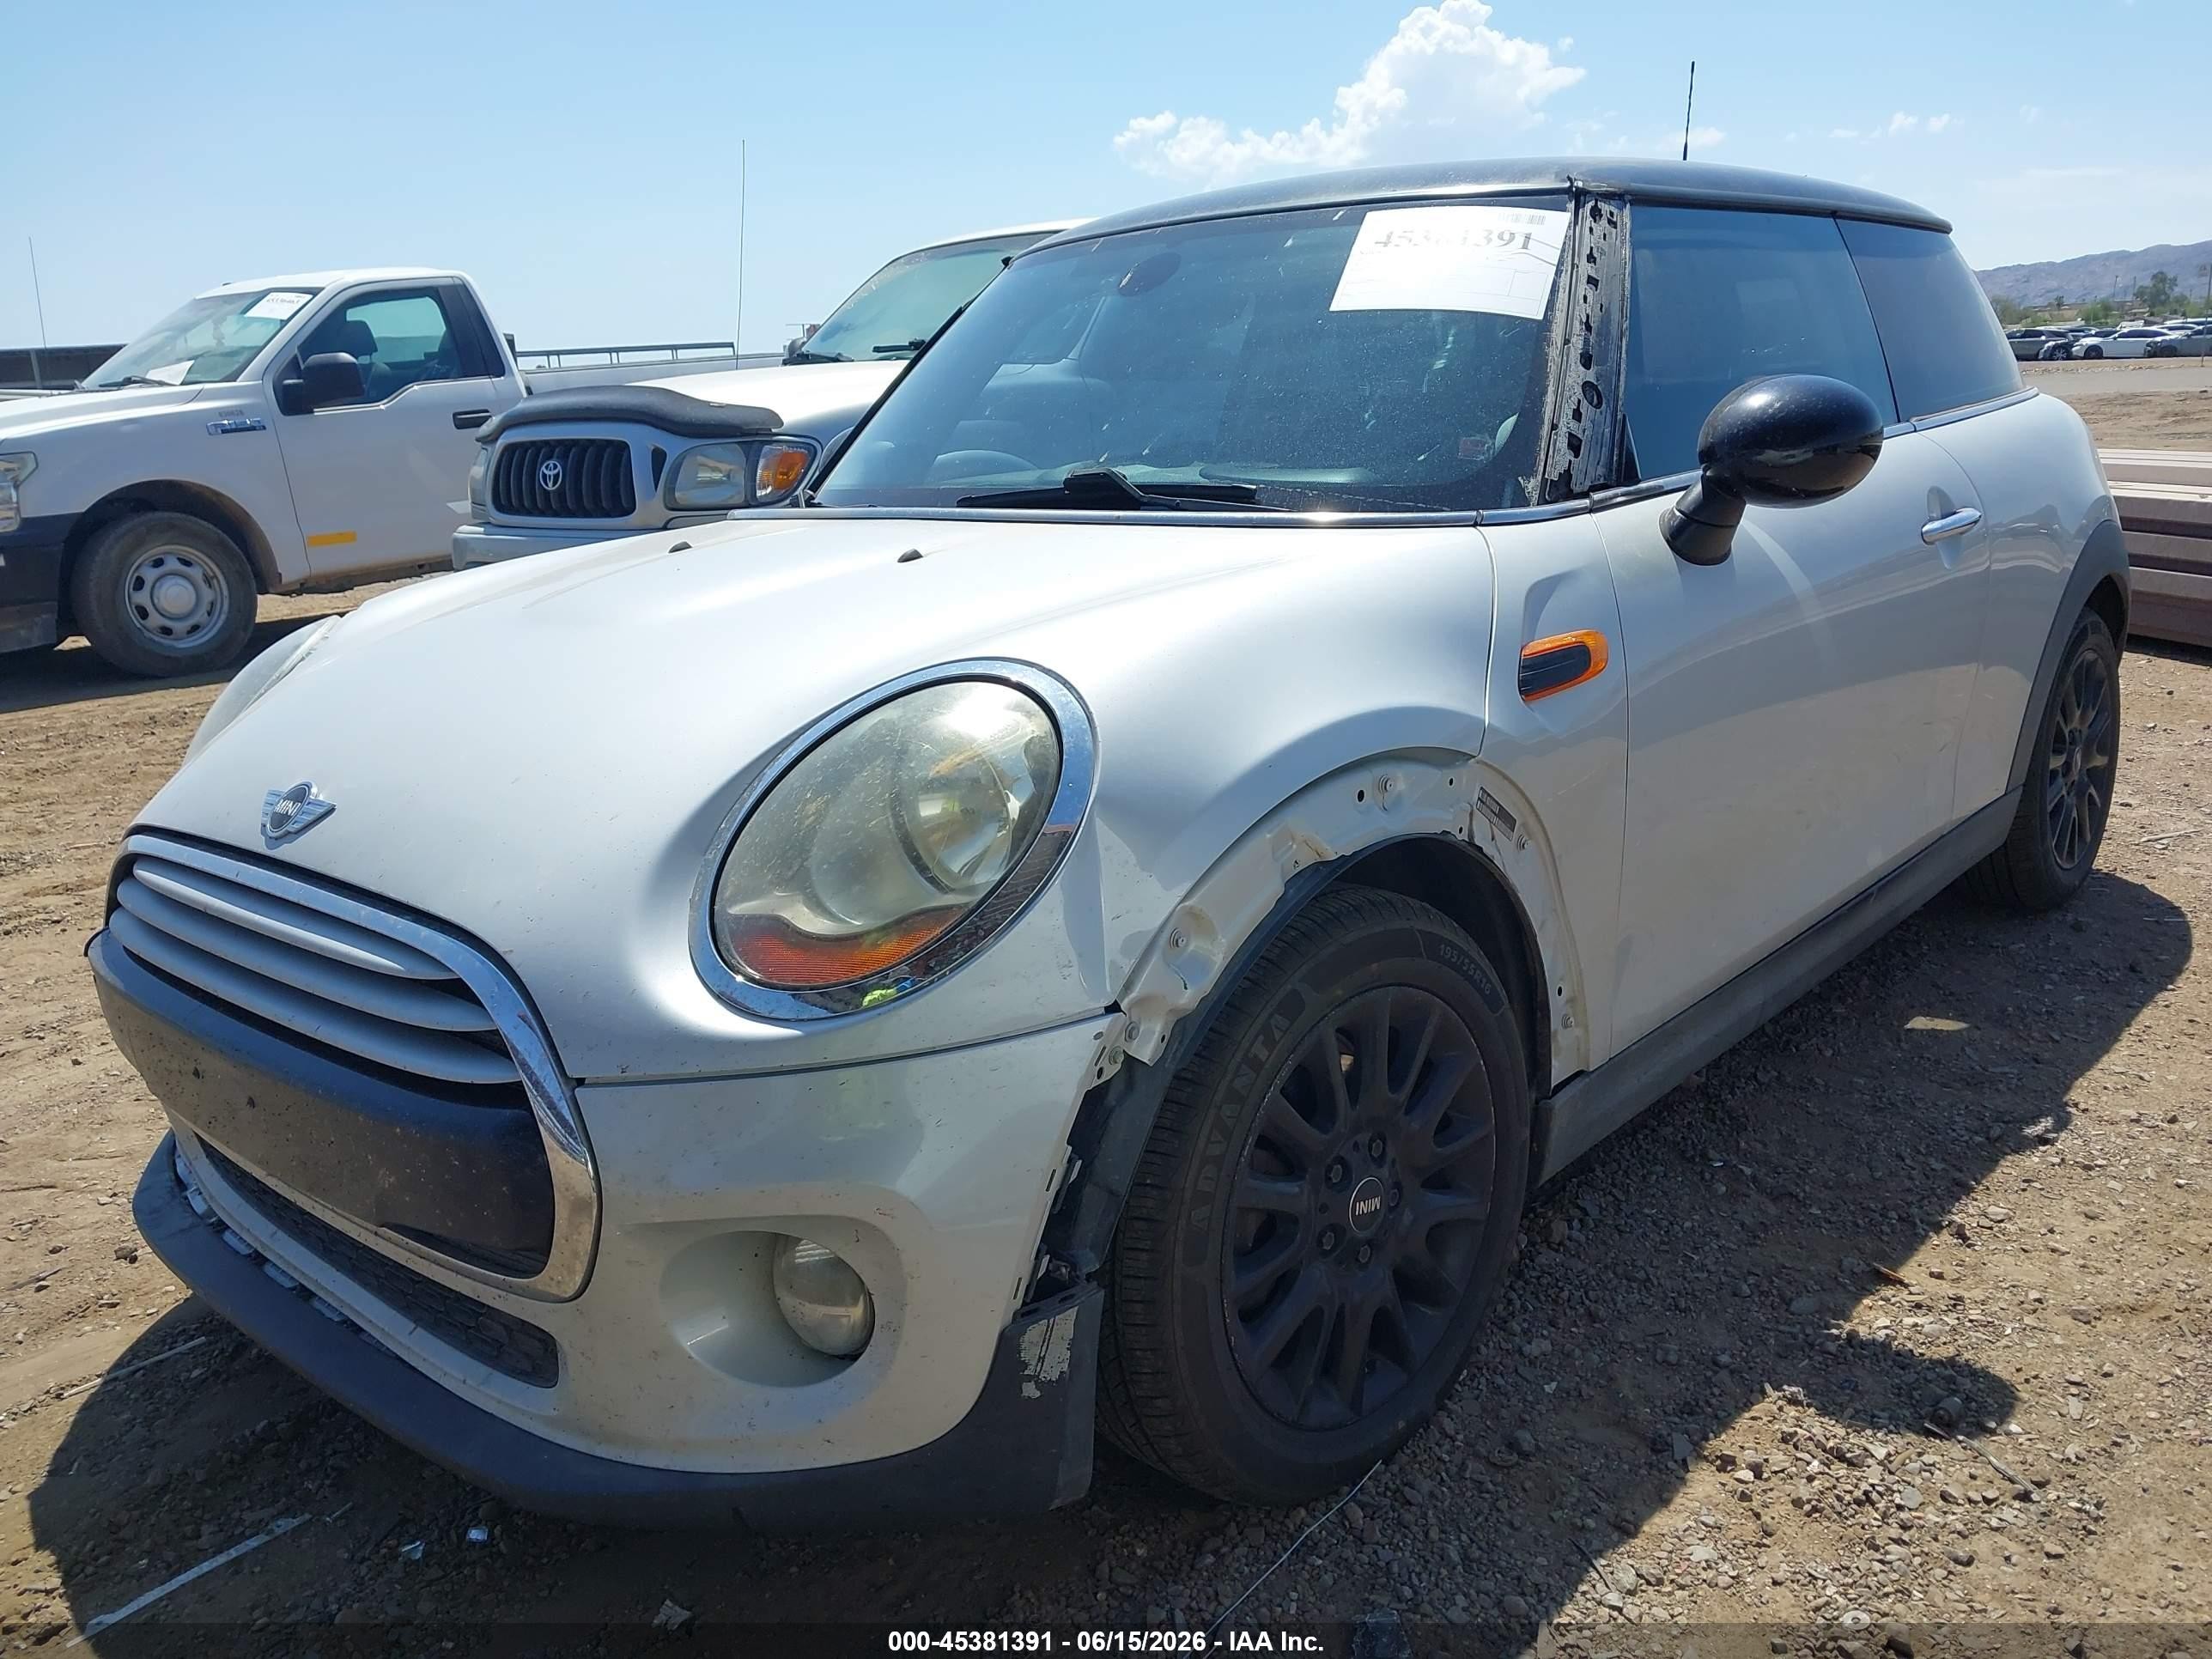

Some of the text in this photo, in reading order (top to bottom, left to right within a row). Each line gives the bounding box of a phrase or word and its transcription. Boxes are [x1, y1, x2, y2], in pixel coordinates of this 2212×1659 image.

[274, 798, 302, 817] MINI
[1439, 944, 1492, 995] 195/55R16
[1189, 1013, 1291, 1231] ADVANTA
[1355, 1195, 1381, 1216] MINI
